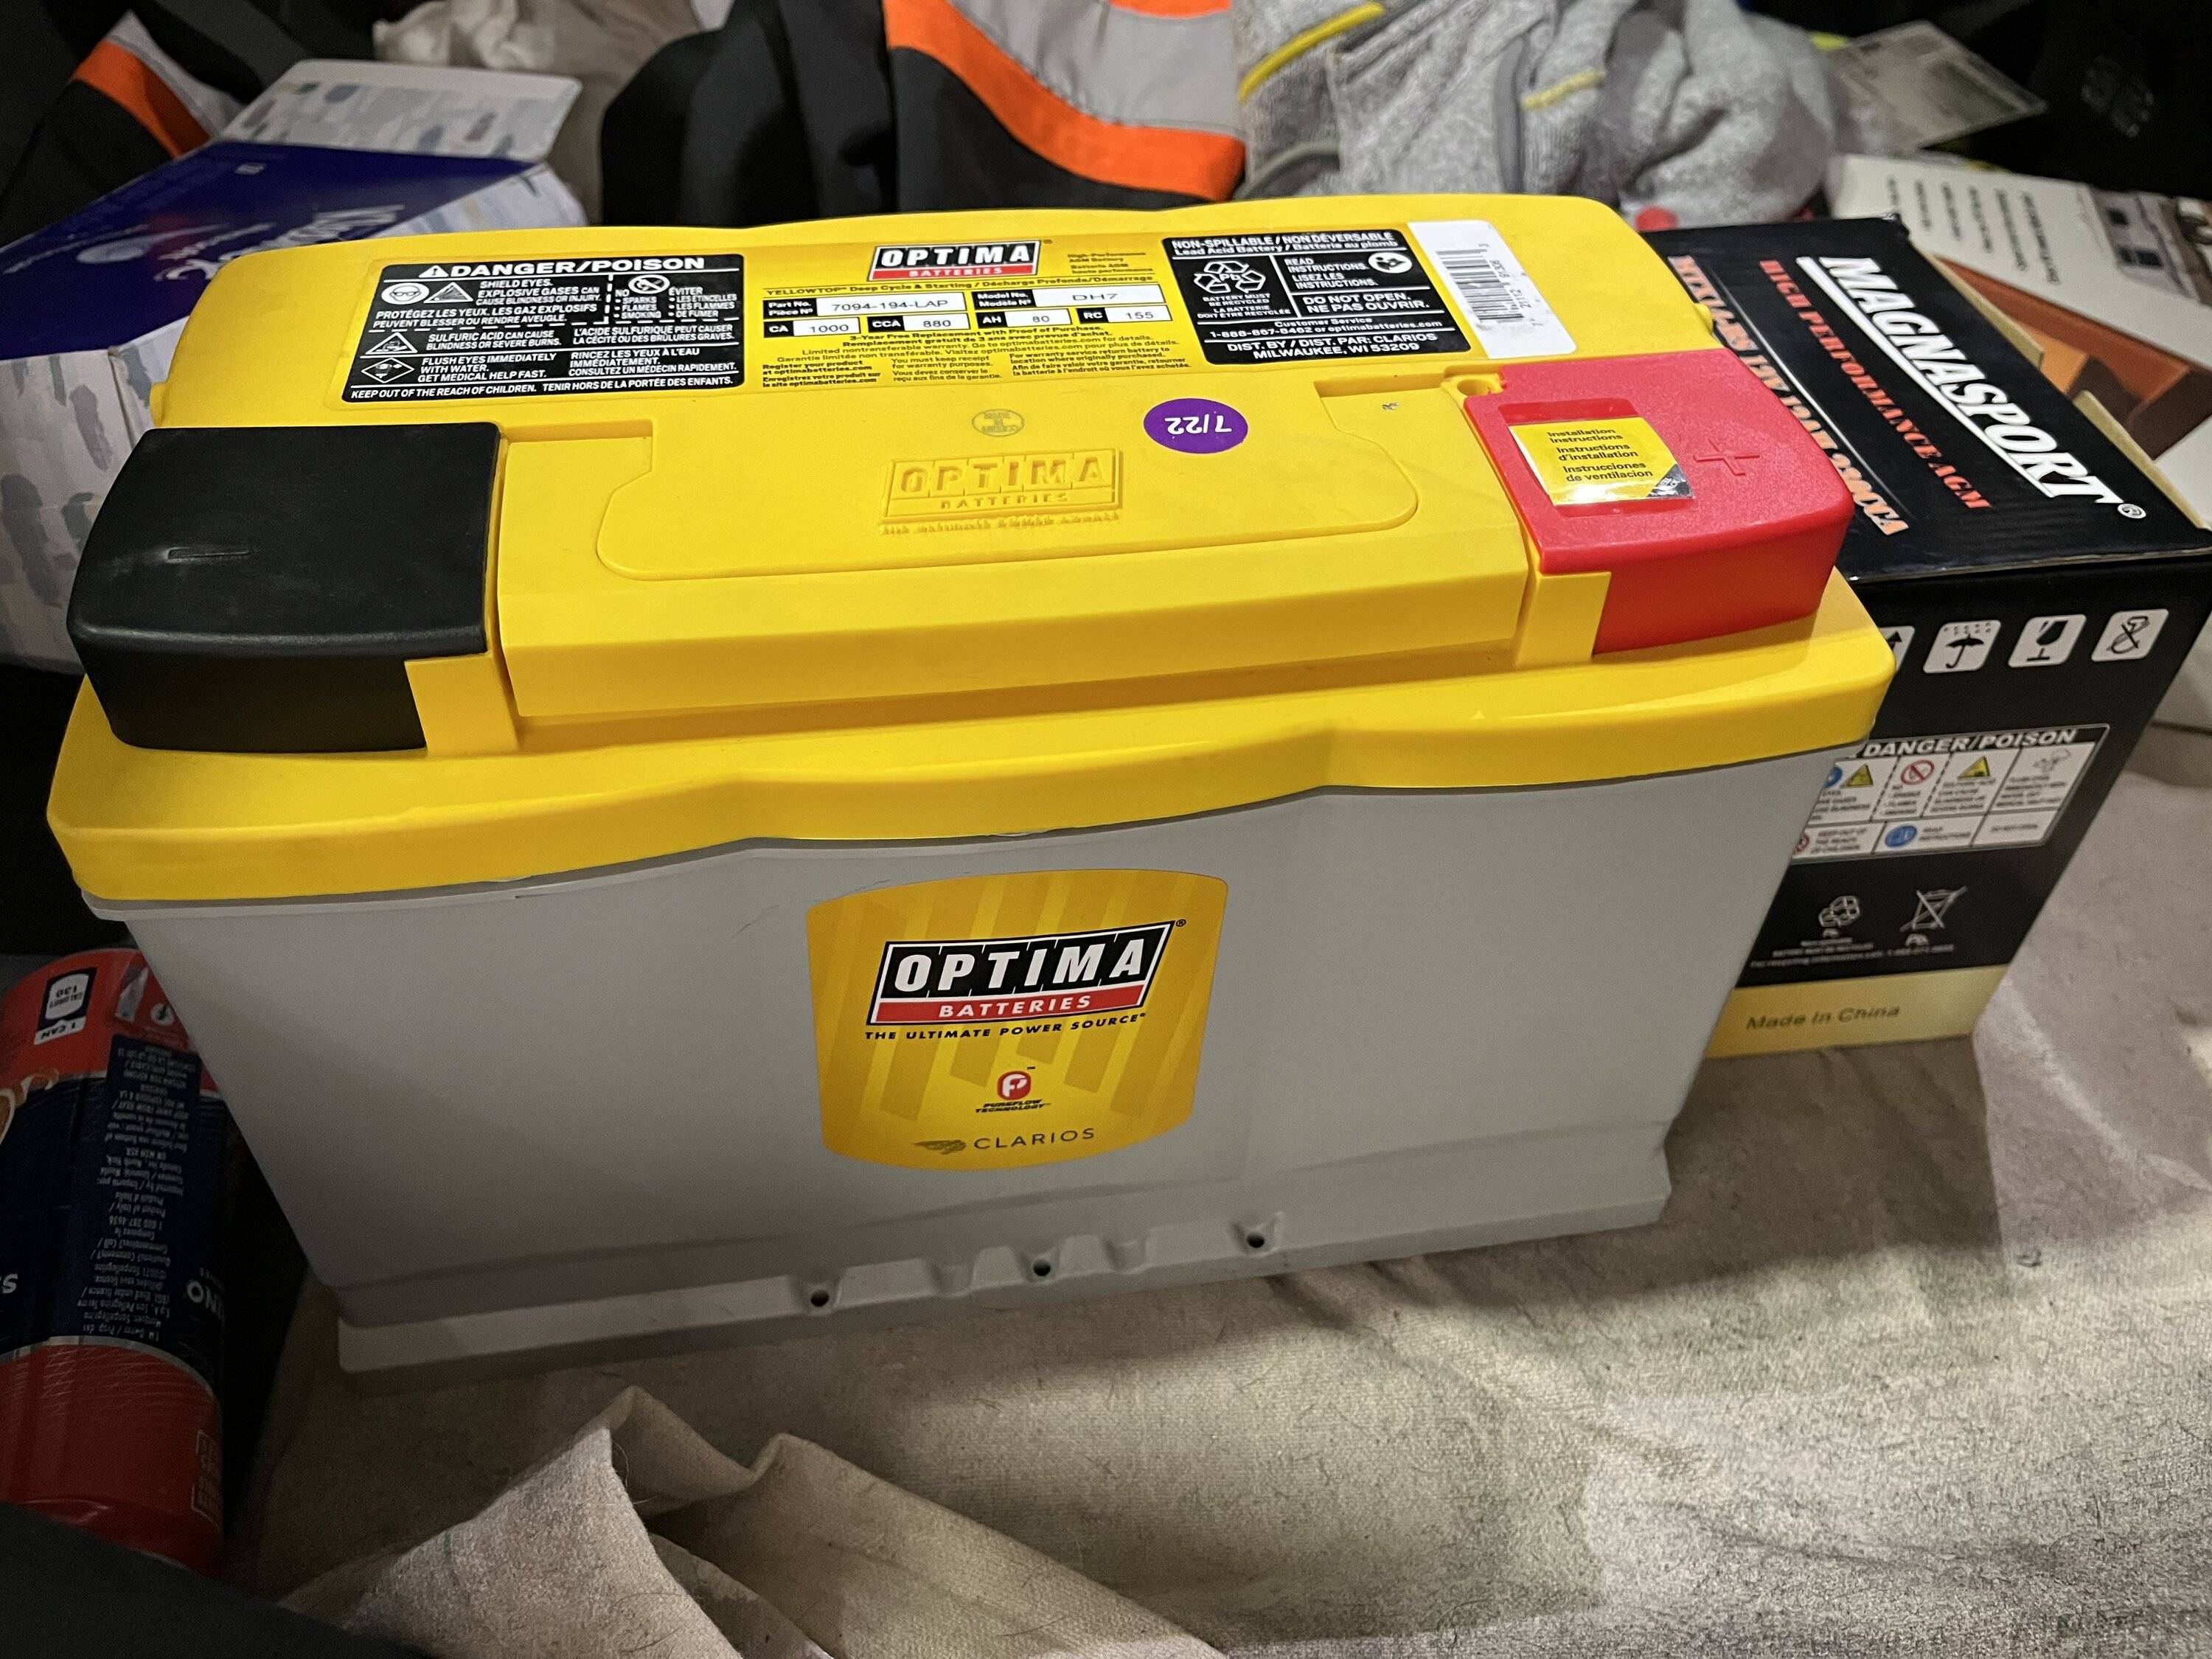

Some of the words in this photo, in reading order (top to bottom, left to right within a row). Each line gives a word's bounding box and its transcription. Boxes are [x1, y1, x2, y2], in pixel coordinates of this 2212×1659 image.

[1172, 236, 1273, 249] NON-SPILLABLE
[1276, 235, 1280, 244] /
[1282, 234, 1312, 244] NON
[881, 246, 1031, 267] OPTIMA
[1284, 257, 1315, 265] READ
[451, 257, 705, 277] DANGER/POISON
[908, 267, 1004, 277] BATTERIES
[1287, 262, 1369, 273] INSTRUCTIONS.
[480, 279, 521, 289] SHIELD
[521, 278, 553, 288] EYES.
[1292, 274, 1322, 282] LISEZ
[849, 285, 878, 293] Deep
[880, 283, 912, 291] Cycle
[925, 281, 973, 289] Starting
[1295, 279, 1378, 290] INSTRUCTIONS.
[478, 288, 540, 298] EXPLOSIVE
[541, 287, 580, 296] GASES
[580, 286, 600, 294] CAN
[614, 289, 630, 297] NO
[977, 292, 1009, 300] Model
[1072, 293, 1119, 301] DH7
[1302, 296, 1326, 305] DO
[1328, 295, 1361, 304] NOT
[1363, 293, 1411, 302] OPEN.
[832, 299, 948, 312] 7094-194-LAP
[1307, 304, 1328, 313] NE
[1333, 302, 1363, 312] PAS
[1365, 300, 1430, 310] OUVRIR.
[375, 309, 435, 320] PROTÉGEZ
[436, 308, 457, 318] LES
[459, 307, 490, 317] YEUX.
[491, 307, 512, 316] LES
[514, 306, 537, 315] GAZ
[538, 304, 597, 313] EXPLOSIFS
[1125, 311, 1154, 319] 155
[872, 319, 902, 328] CCA
[982, 316, 1002, 324] AH
[1274, 319, 1328, 327] Customer
[1330, 316, 1373, 324] Service
[574, 327, 611, 337] L'ACIDE
[611, 325, 674, 335] SULFURIQUE
[675, 325, 698, 333] PEUT
[698, 324, 734, 333] CAUSER
[768, 325, 789, 333] CA
[811, 324, 849, 333] 1000
[1327, 320, 1442, 333] optimabatteries.com
[428, 333, 479, 342] SULFURIC
[479, 332, 504, 341] ACID
[504, 331, 524, 340] CAN
[524, 330, 554, 339] CAUSE
[912, 331, 982, 340] Replacement
[425, 341, 478, 351] BLINDNESS
[478, 341, 492, 349] OR
[492, 339, 527, 348] SEVERE
[528, 338, 562, 347] BURNS.
[1227, 342, 1265, 352] DIST.
[1267, 341, 1285, 349] BY
[1290, 339, 1295, 347] /
[1299, 338, 1337, 347] DIST.
[1340, 336, 1372, 345] PAR:
[1373, 333, 1438, 344] CLARIOS
[571, 350, 610, 360] RINCEZ
[611, 349, 632, 358] LES
[633, 348, 661, 358] YEUX
[661, 347, 670, 356] À
[670, 347, 700, 356] L'EAU
[1253, 346, 1348, 359] MILWAUKEE,
[1350, 345, 1369, 353] WI
[1373, 342, 1419, 352] 53209
[422, 357, 457, 366] FLUSH
[457, 356, 486, 364] EYES
[487, 352, 557, 364] IMMEDIATELY
[420, 366, 449, 374] WITH
[450, 364, 490, 372] WATER.
[568, 367, 622, 377] CONSULTEZ
[622, 366, 636, 375] UN
[678, 362, 737, 372] RAPIDEMENT.
[417, 373, 441, 383] GET
[441, 372, 488, 382] MEDICAL
[488, 371, 517, 380] HELP
[518, 369, 547, 379] FAST.
[542, 383, 571, 392] TENIR
[571, 381, 600, 391] HORS
[600, 380, 614, 389] DE
[614, 380, 627, 389] LA
[627, 378, 666, 387] PORTÉE
[667, 378, 687, 386] DES
[687, 376, 734, 386] ENFANTS.
[1759, 259, 1812, 308] HIGH
[1798, 310, 1941, 462] PERFORMANCE
[1927, 461, 1992, 509] AGM
[351, 389, 380, 399] KEEP
[379, 389, 400, 397] OUT
[401, 388, 416, 397] OF
[416, 387, 437, 397] THE
[437, 386, 471, 396] REACH
[471, 386, 487, 394] OF
[487, 383, 537, 394] CHILDREN.
[1164, 414, 1233, 436] 7/22
[1547, 428, 1616, 437] Installation
[1550, 434, 1624, 443] Instructions
[1556, 443, 1631, 453] Instructions
[1559, 451, 1639, 461] d'installation
[1563, 462, 1646, 473] Instrucciones
[900, 456, 1105, 494] OPTIMA
[1584, 470, 1653, 481] ventilacion
[940, 493, 1069, 509] BATTERIES
[1863, 728, 2077, 759] DANGER/POISON
[893, 938, 1144, 993] OPTIMA
[938, 995, 1093, 1018] BATTERIES
[1745, 1015, 1806, 1030] Made
[1837, 1006, 1901, 1023] China
[864, 1031, 897, 1040] THE
[905, 1028, 990, 1040] ULTIMATE
[999, 1023, 1063, 1037] POWER
[975, 1104, 1044, 1113] TECHNOLOGY
[983, 1099, 1043, 1107] PUREFLOW
[973, 1127, 1095, 1151] CLARIOS
